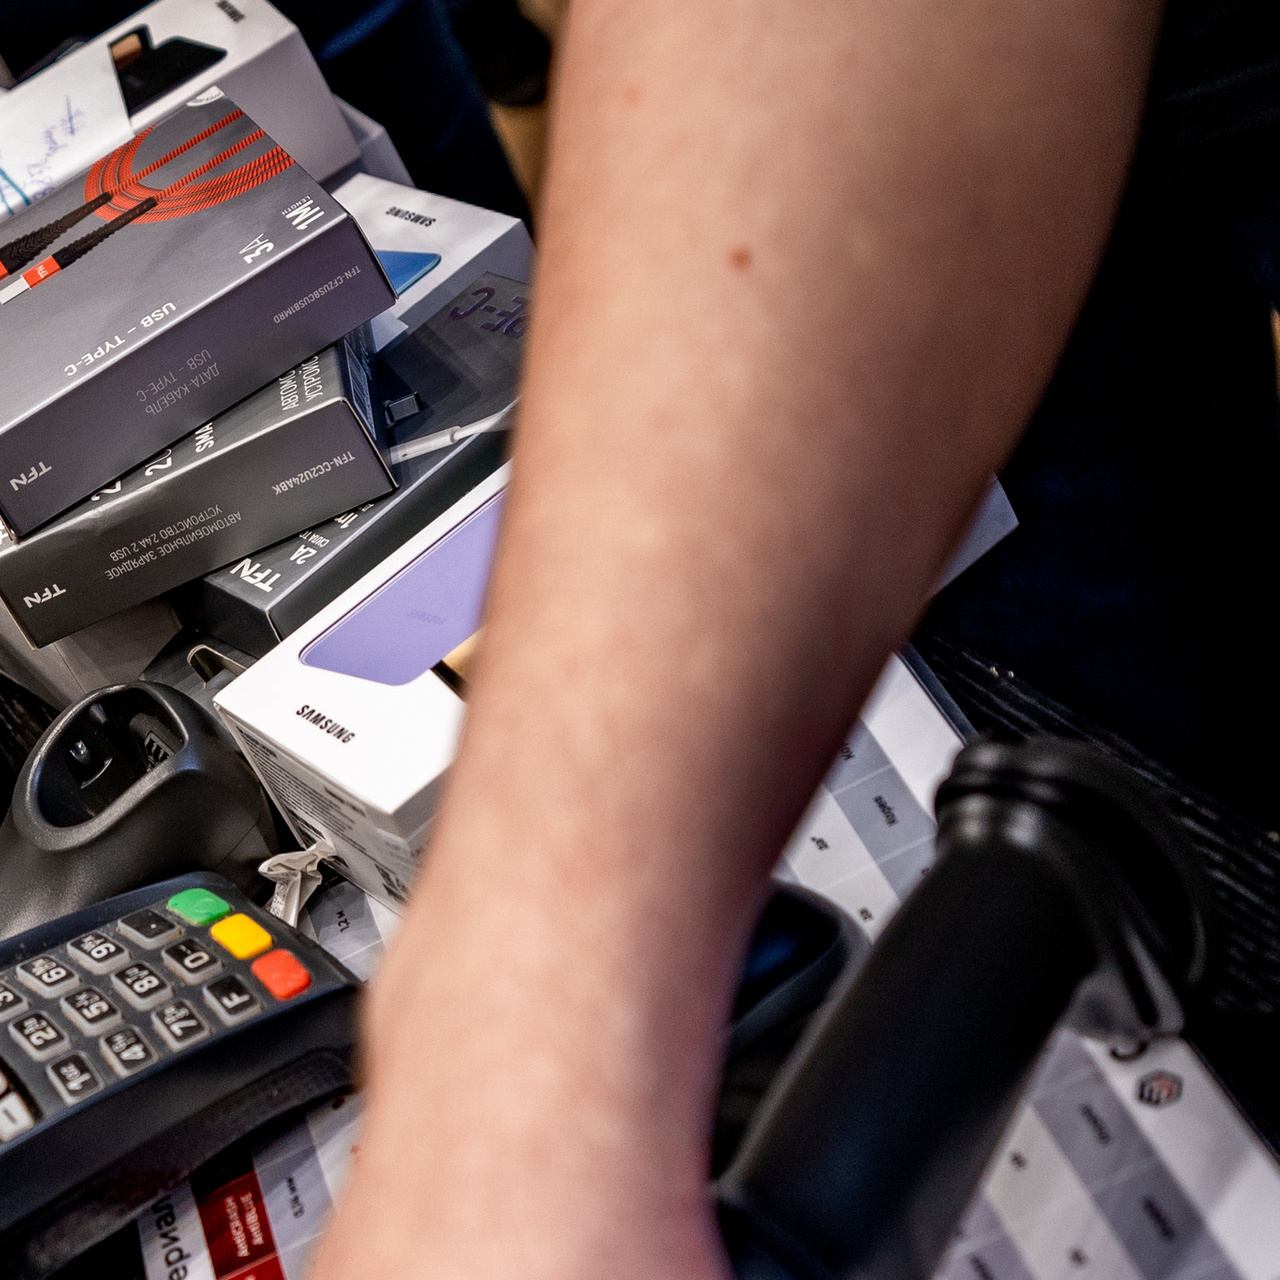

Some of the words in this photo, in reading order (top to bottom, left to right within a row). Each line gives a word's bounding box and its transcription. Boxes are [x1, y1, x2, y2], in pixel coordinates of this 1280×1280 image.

[282, 195, 311, 216] LENGTH
[285, 199, 325, 231] 1M
[386, 206, 436, 227] SAMSUNG
[238, 233, 275, 264] 3A
[37, 264, 49, 279] TFN
[140, 301, 177, 328] USB
[64, 334, 126, 377] TYPE-C
[186, 348, 212, 371] USB
[136, 370, 179, 403] TYPE-C
[145, 362, 220, 415] ДАТА-КАБЕЛЬ
[9, 461, 53, 492] TFN
[271, 450, 356, 496] TFN-CC2U24ABK
[159, 510, 243, 558] АВТОМОБИЛЬНОЕ
[162, 503, 224, 542] УСТРОЙСТВО
[109, 545, 132, 563] USB
[289, 543, 318, 566] 2A
[104, 552, 158, 581] ЗАРЯДНОЕ
[229, 557, 282, 594] TFN
[23, 583, 67, 609] TFN
[296, 704, 356, 744] SAMSUNG
[91, 936, 117, 959] 9
[183, 951, 210, 969] 0
[41, 966, 68, 984] 6
[132, 975, 160, 994] 8
[81, 1000, 110, 1020] 5
[221, 992, 251, 1009] F
[29, 1025, 58, 1047] 2
[169, 1019, 198, 1037] 7
[120, 1042, 147, 1061] 4
[66, 1071, 92, 1091] 1
